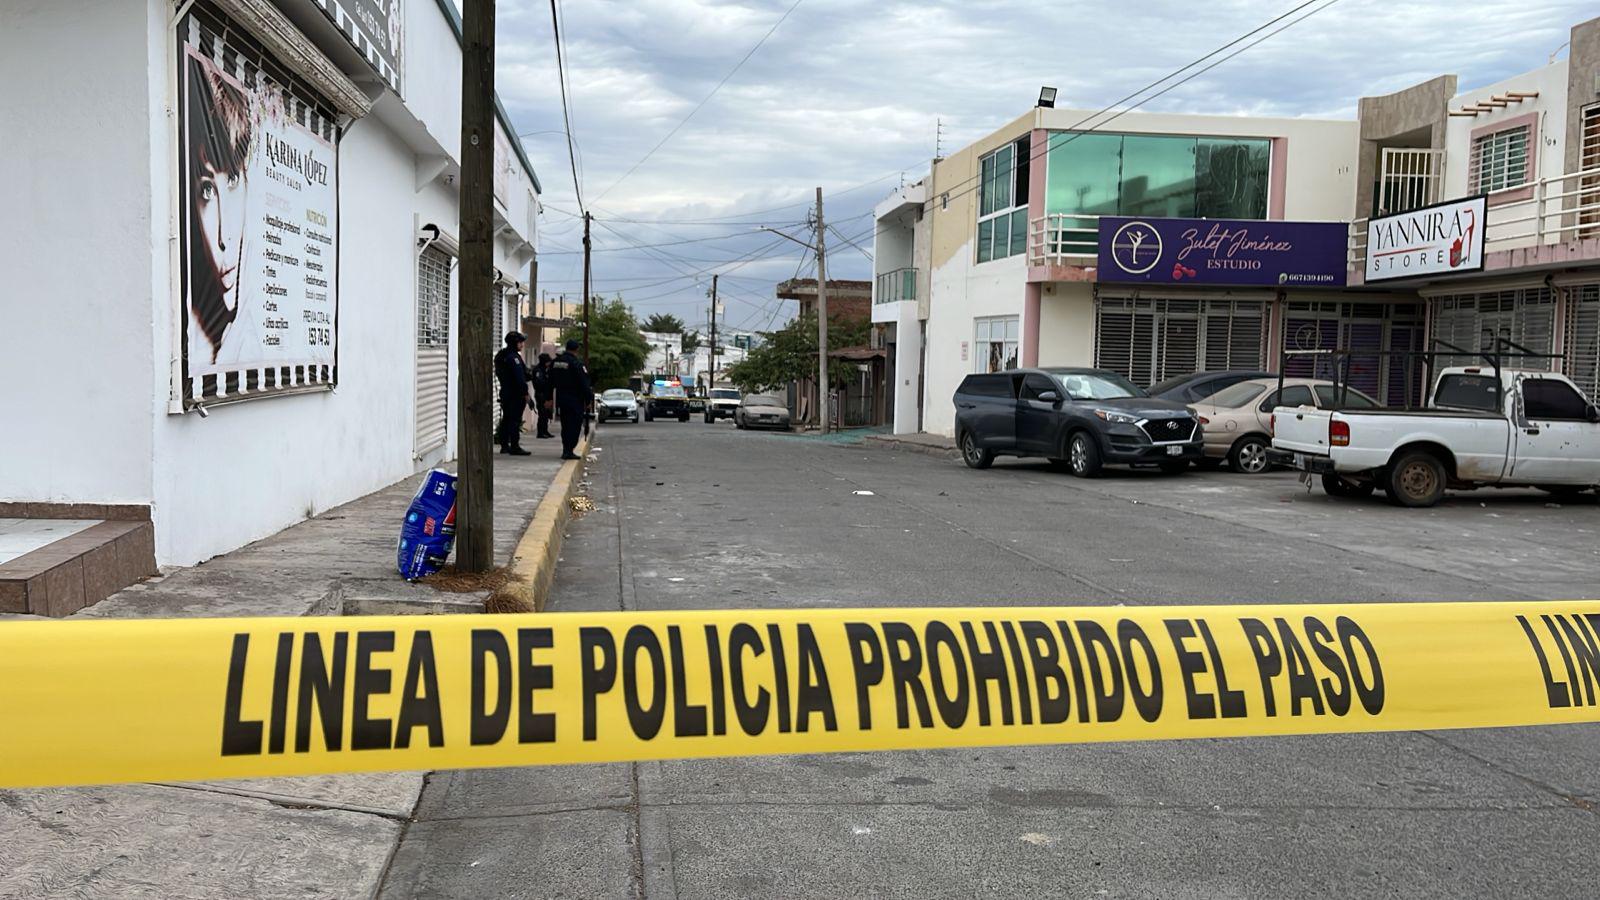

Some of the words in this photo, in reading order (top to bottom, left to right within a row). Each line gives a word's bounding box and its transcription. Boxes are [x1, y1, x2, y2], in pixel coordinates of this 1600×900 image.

[266, 132, 302, 174] KARINA
[305, 149, 327, 187] LÓPEZ
[266, 166, 285, 183] BEAUTY
[287, 176, 301, 191] SALON
[1177, 223, 1231, 260] Zulet
[1227, 229, 1292, 257] Jiménez
[1375, 209, 1463, 250] YANNIRA
[1207, 259, 1261, 270] ESTUDIO
[1374, 250, 1444, 272] STORE
[308, 327, 316, 346] 153
[317, 328, 323, 346] 74
[324, 328, 330, 346] 53
[1515, 613, 1600, 708] LIN
[221, 630, 445, 757] LINEA
[470, 627, 557, 747] DE
[578, 623, 839, 742] POLICIA
[843, 618, 1164, 731] PROHIBIDO
[1162, 618, 1248, 720] EL
[1238, 614, 1385, 717] PASO
